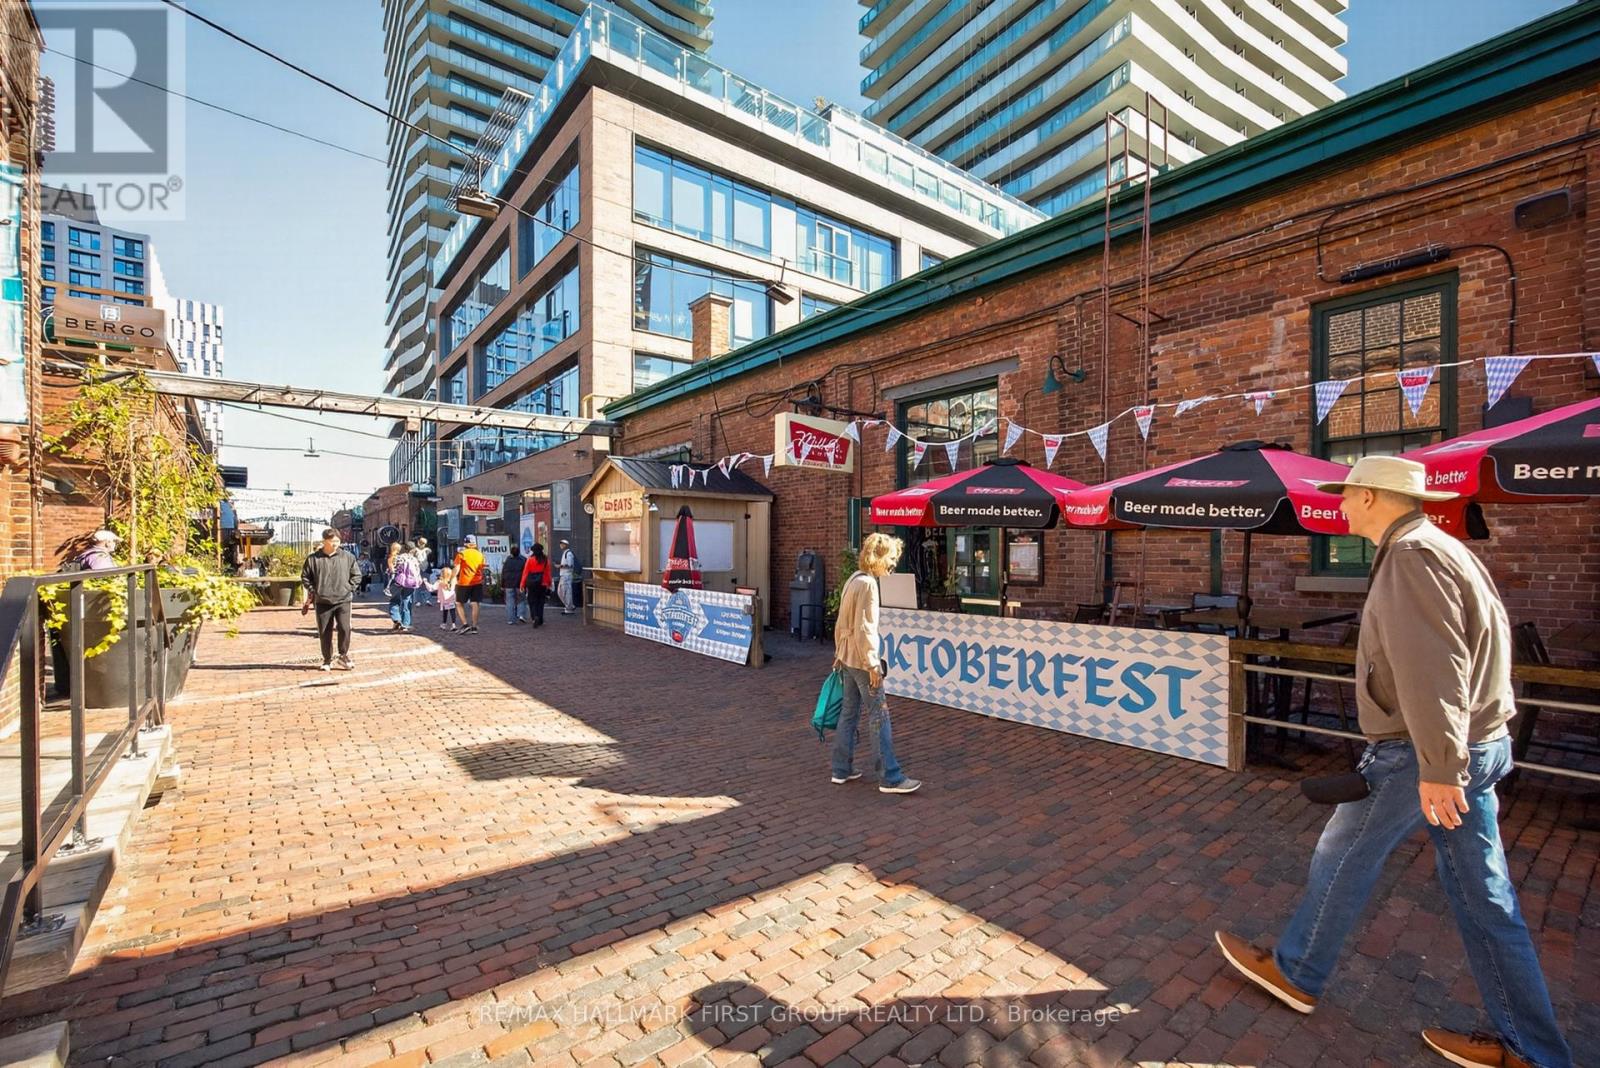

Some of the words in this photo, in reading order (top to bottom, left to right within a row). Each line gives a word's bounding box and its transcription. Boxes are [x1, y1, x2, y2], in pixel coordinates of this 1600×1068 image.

[65, 317, 155, 338] BERGO
[1513, 463, 1580, 480] Beer
[613, 498, 633, 512] EATS
[940, 505, 965, 516] Beer
[967, 505, 1001, 517] made
[1003, 505, 1043, 518] better.
[1124, 501, 1157, 514] Beer
[1160, 503, 1205, 517] made
[1208, 503, 1266, 518] better.
[1301, 505, 1338, 520] Beer
